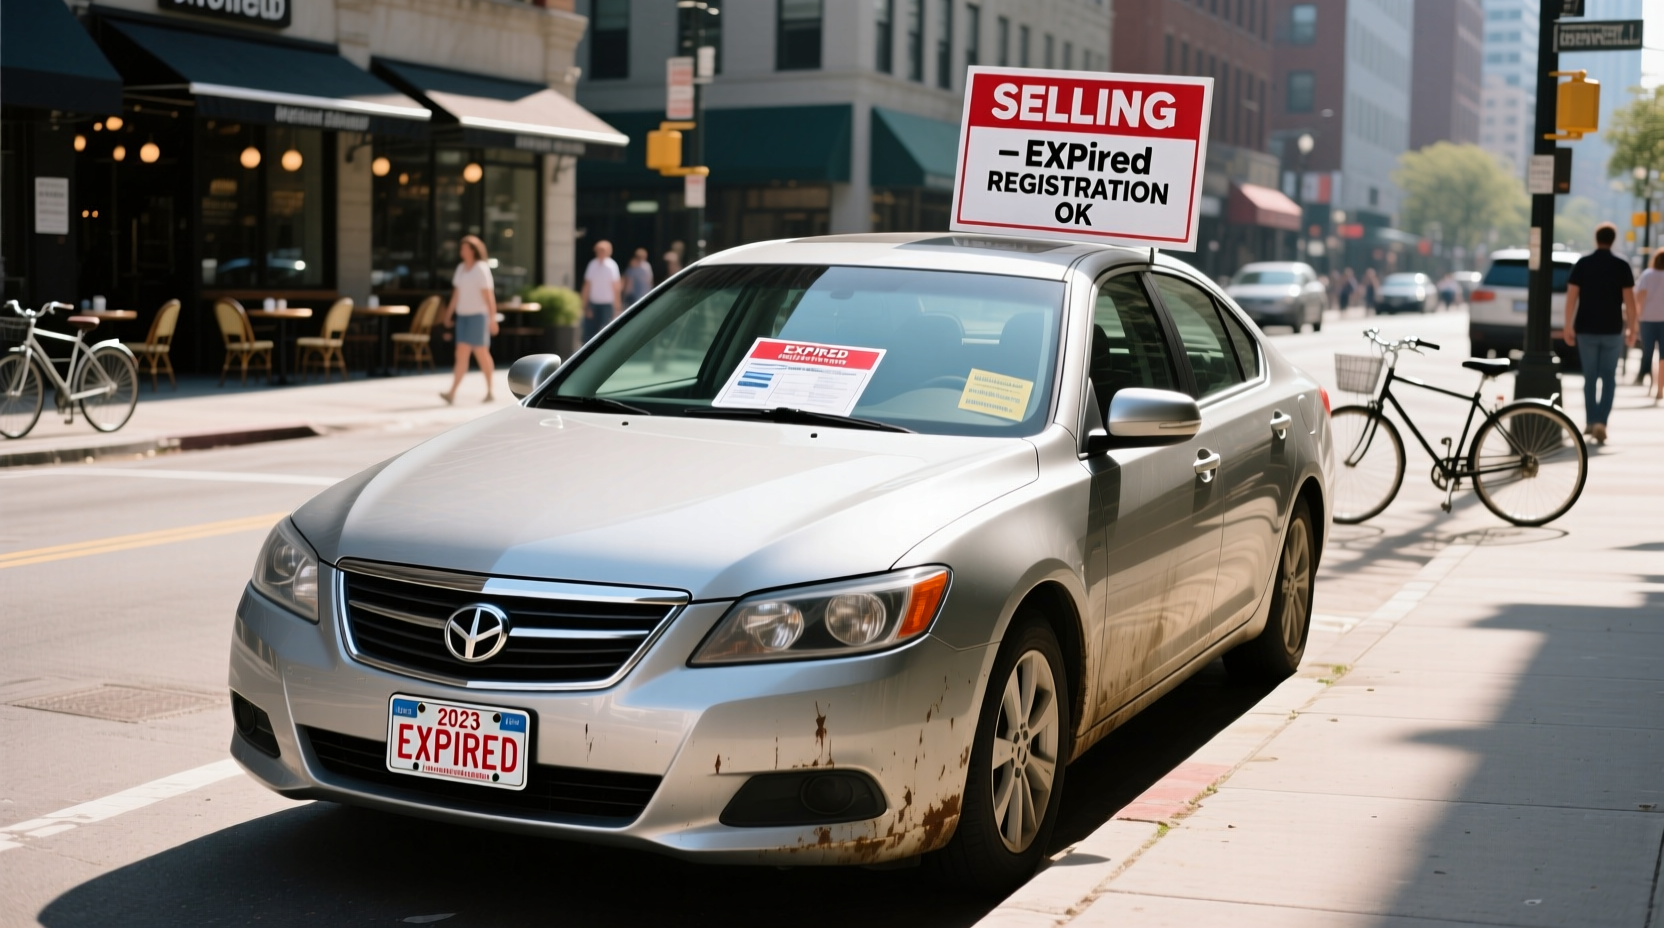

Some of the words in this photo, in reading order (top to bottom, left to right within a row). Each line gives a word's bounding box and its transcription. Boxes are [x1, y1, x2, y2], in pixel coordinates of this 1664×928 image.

[991, 82, 1177, 130] SELLING
[1025, 139, 1153, 175] EXPired
[987, 170, 1169, 205] REGISTRATION
[1054, 202, 1094, 226] OK
[783, 344, 849, 359] EXPIRED
[437, 708, 480, 731] 2023
[397, 723, 518, 773] EXPIRED
